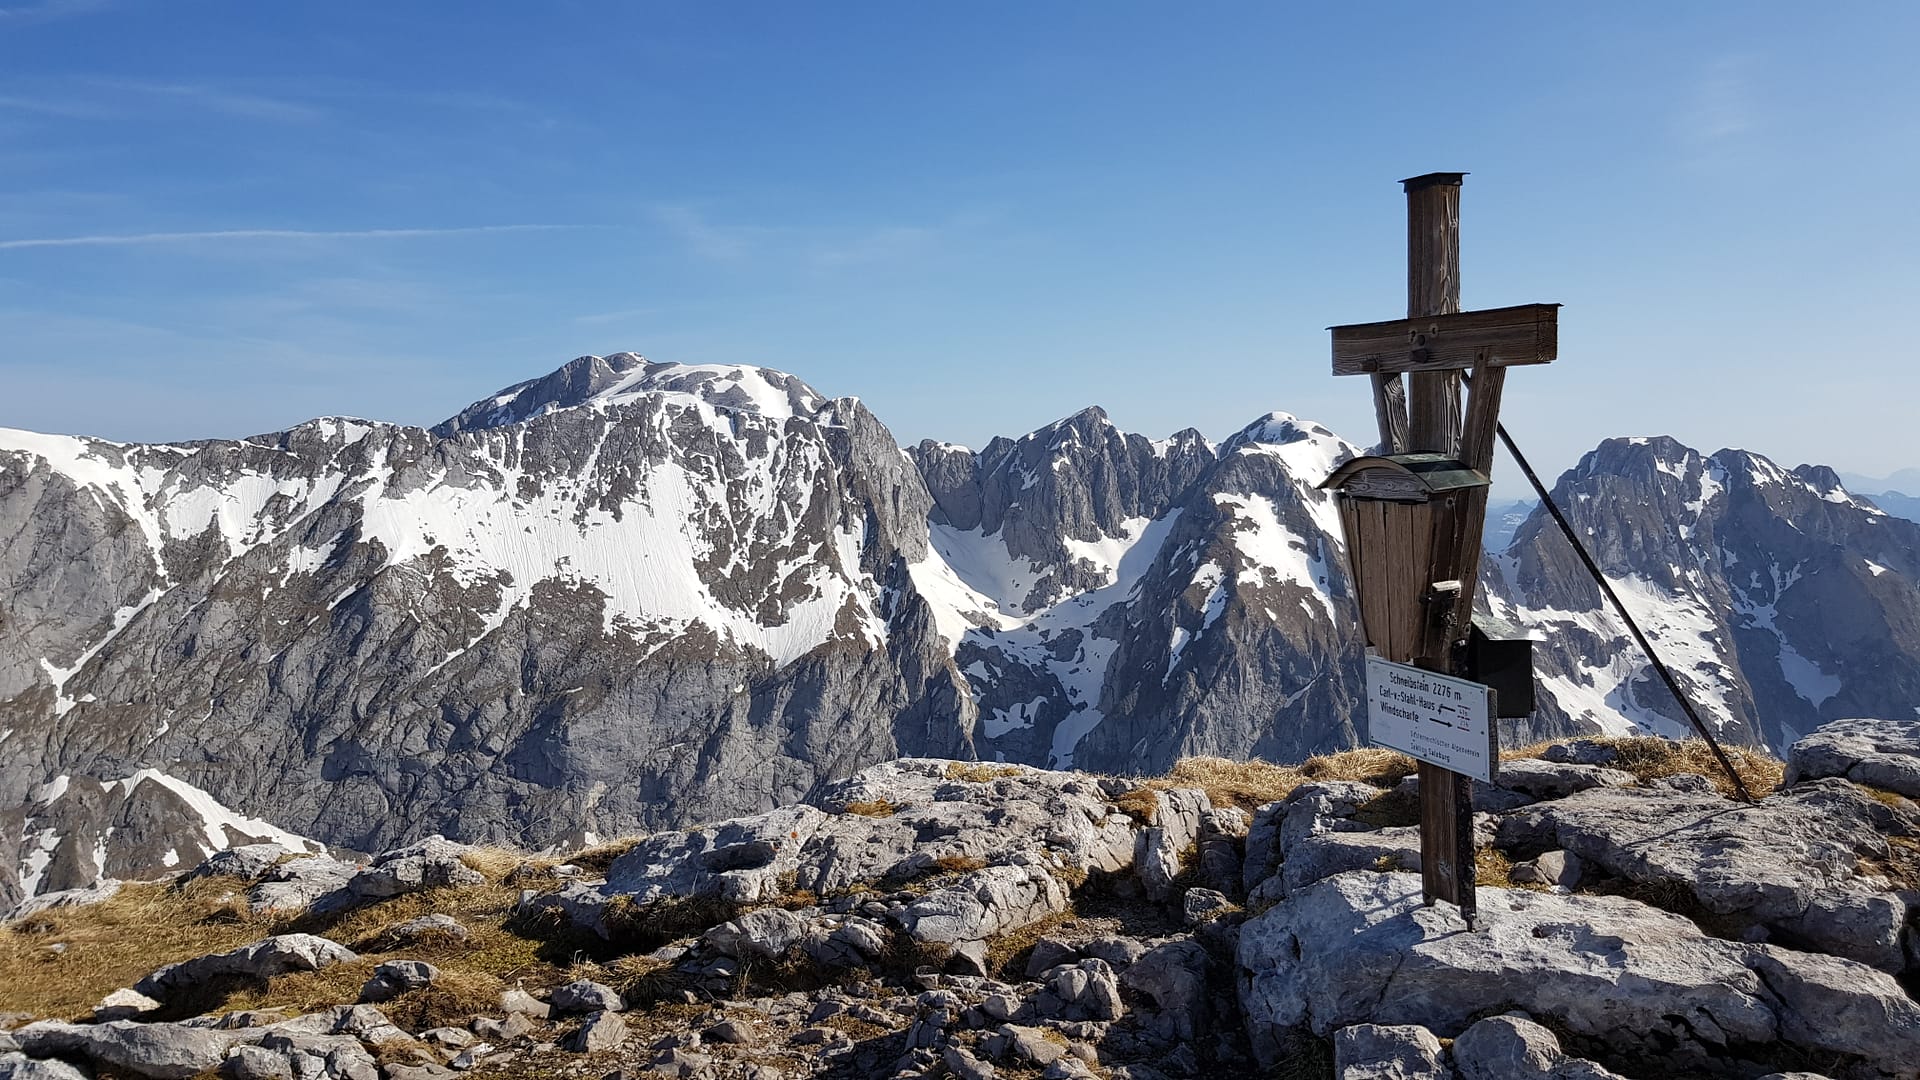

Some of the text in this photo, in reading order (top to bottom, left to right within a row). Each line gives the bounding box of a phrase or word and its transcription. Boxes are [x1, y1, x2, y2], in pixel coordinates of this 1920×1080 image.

[1389, 671, 1429, 692] Schneibstein
[1432, 682, 1451, 698] 2276
[1428, 747, 1450, 763] Salzburg
